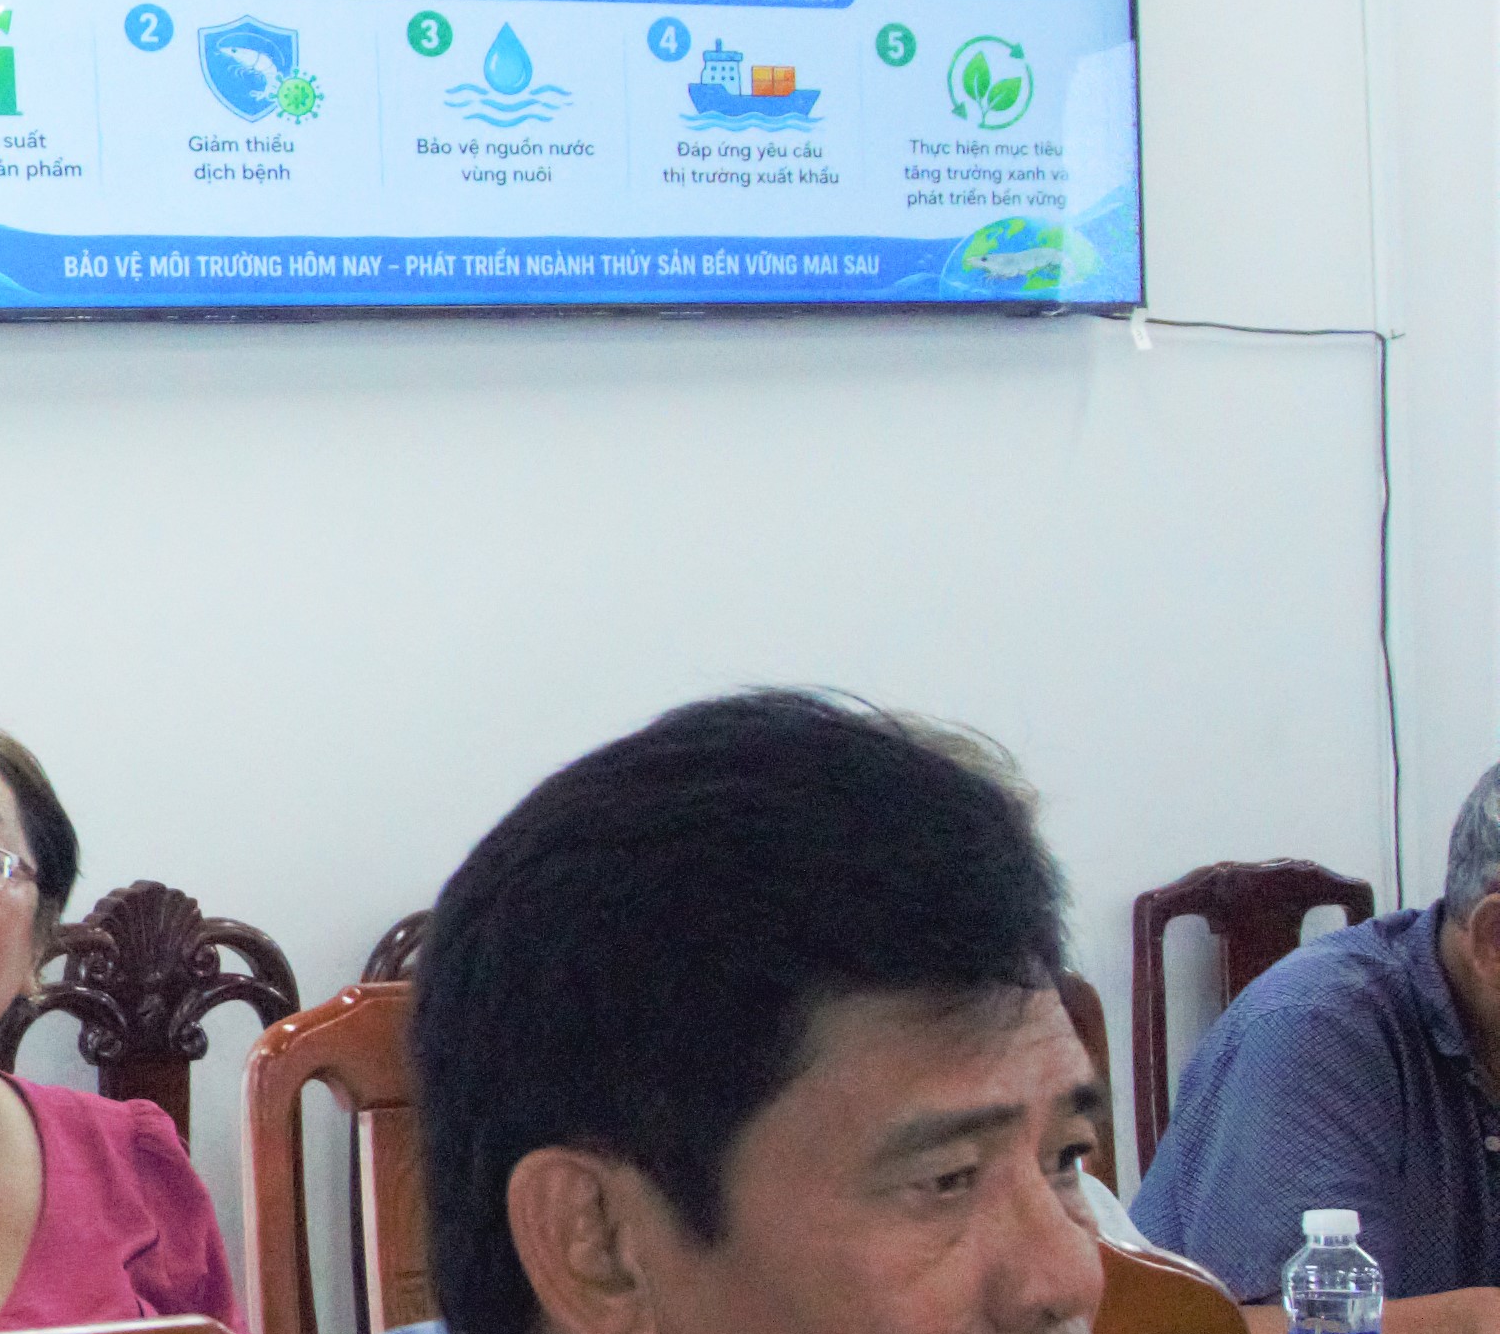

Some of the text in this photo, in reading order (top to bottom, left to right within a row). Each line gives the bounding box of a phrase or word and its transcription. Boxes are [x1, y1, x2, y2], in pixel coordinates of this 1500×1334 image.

[138, 11, 161, 44] 2
[420, 19, 439, 49] 3
[658, 25, 680, 55] 4
[886, 32, 907, 60] 5
[2, 129, 47, 150] suất
[187, 132, 296, 155] Giảm thiểu
[416, 136, 596, 160] Bảo vệ nguồn nước
[676, 140, 824, 162] Đáp ứng yêu cầu
[25, 157, 84, 182] phẩm
[193, 162, 291, 185] dịch bệnh
[461, 165, 553, 187] vùng nuôi
[662, 166, 841, 189] thị trường xuất khẩu
[63, 248, 109, 279] BẢO
[114, 250, 143, 282] VỆ
[149, 250, 192, 278] MÔI
[195, 250, 284, 279] TRƯỜNG
[288, 250, 337, 277] HÔM
[342, 255, 383, 277] NAY
[405, 250, 457, 277] PHÁT
[461, 246, 521, 277] TRIỂN
[525, 250, 595, 277] NGÀNH
[601, 249, 652, 276] THỦY
[657, 248, 697, 276] SẢN
[701, 248, 741, 277] BỀN
[745, 250, 798, 276] VỮNG
[803, 254, 839, 275] MAI
[843, 254, 880, 275] SAU
